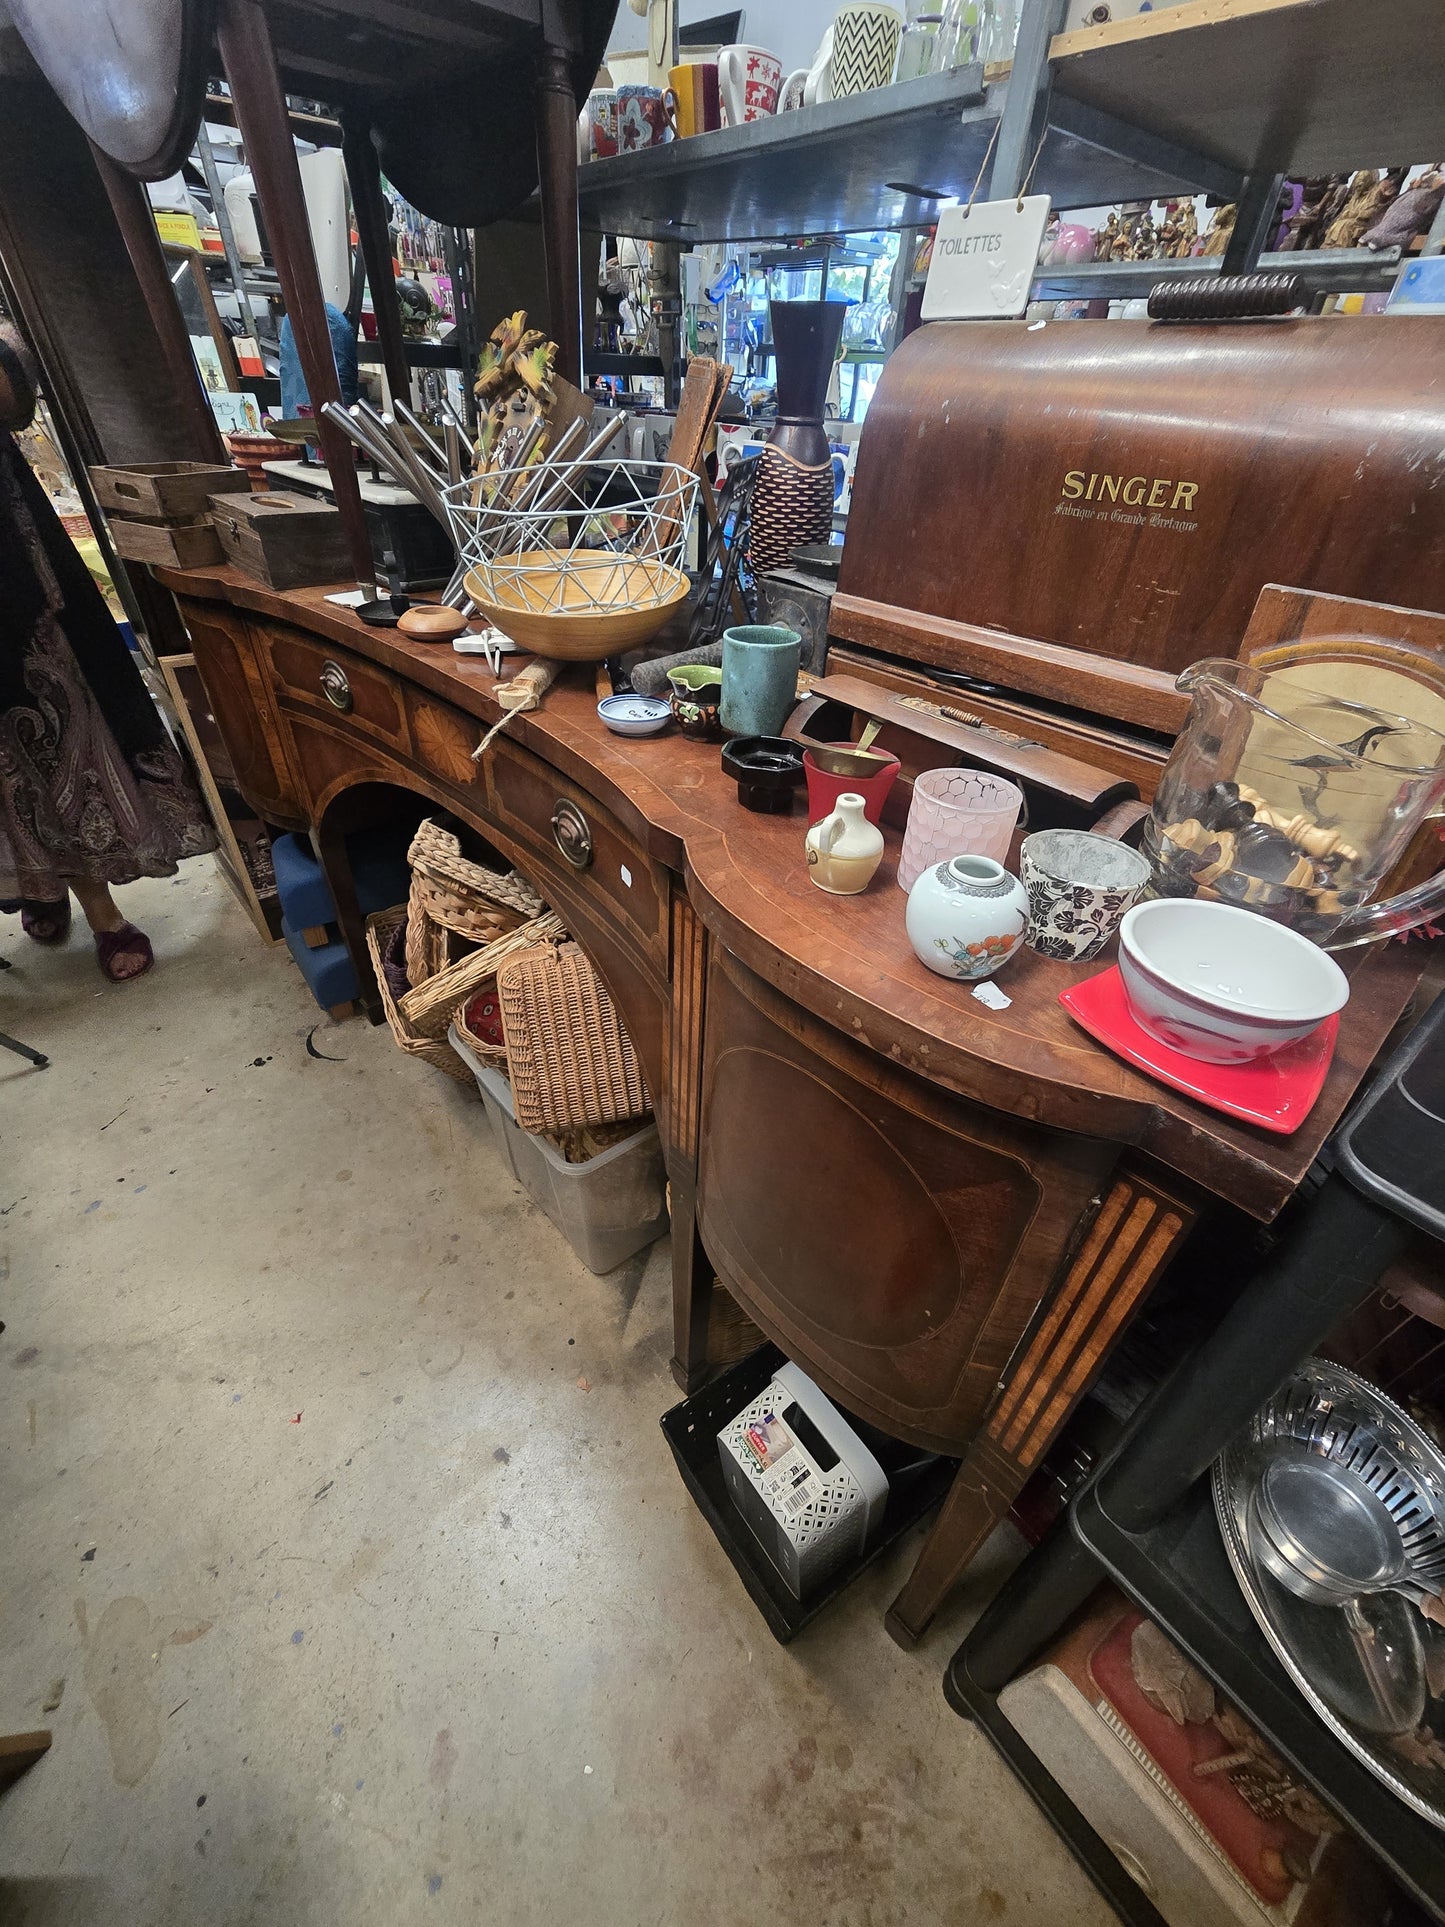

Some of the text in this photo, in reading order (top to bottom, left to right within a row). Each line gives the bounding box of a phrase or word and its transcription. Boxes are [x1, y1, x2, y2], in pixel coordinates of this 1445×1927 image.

[939, 234, 1002, 256] TOILETTES
[1062, 470, 1199, 511] SINGER
[1096, 511, 1108, 522] en
[1110, 508, 1147, 526] Grande
[1150, 512, 1198, 533] Bretagne
